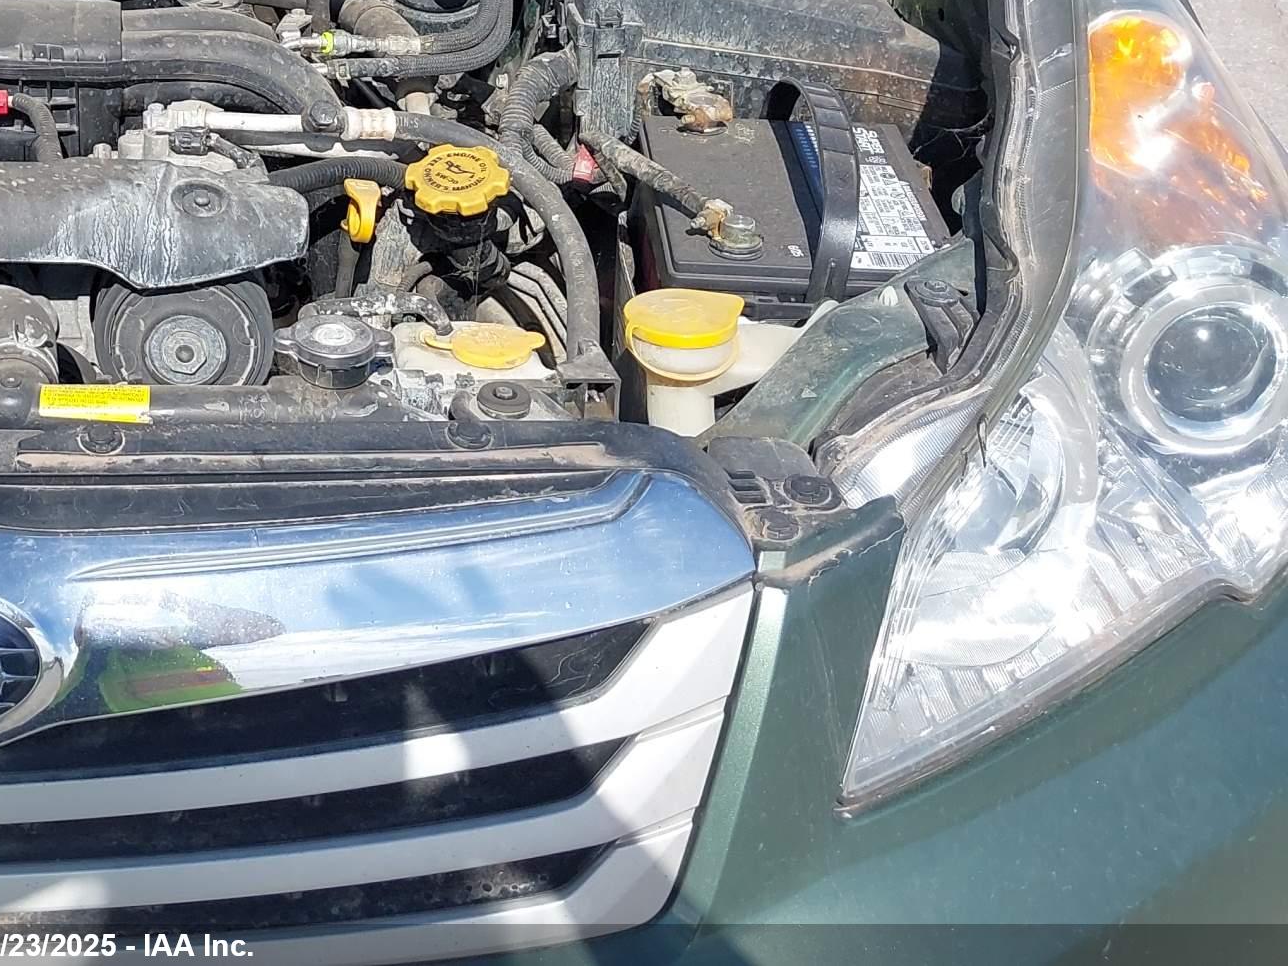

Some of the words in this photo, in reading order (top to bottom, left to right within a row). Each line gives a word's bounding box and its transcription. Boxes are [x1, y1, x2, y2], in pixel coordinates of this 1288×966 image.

[852, 127, 873, 153] START
[447, 152, 481, 162] ENGINE
[479, 162, 488, 172] OIL
[452, 175, 486, 191] MANUAL
